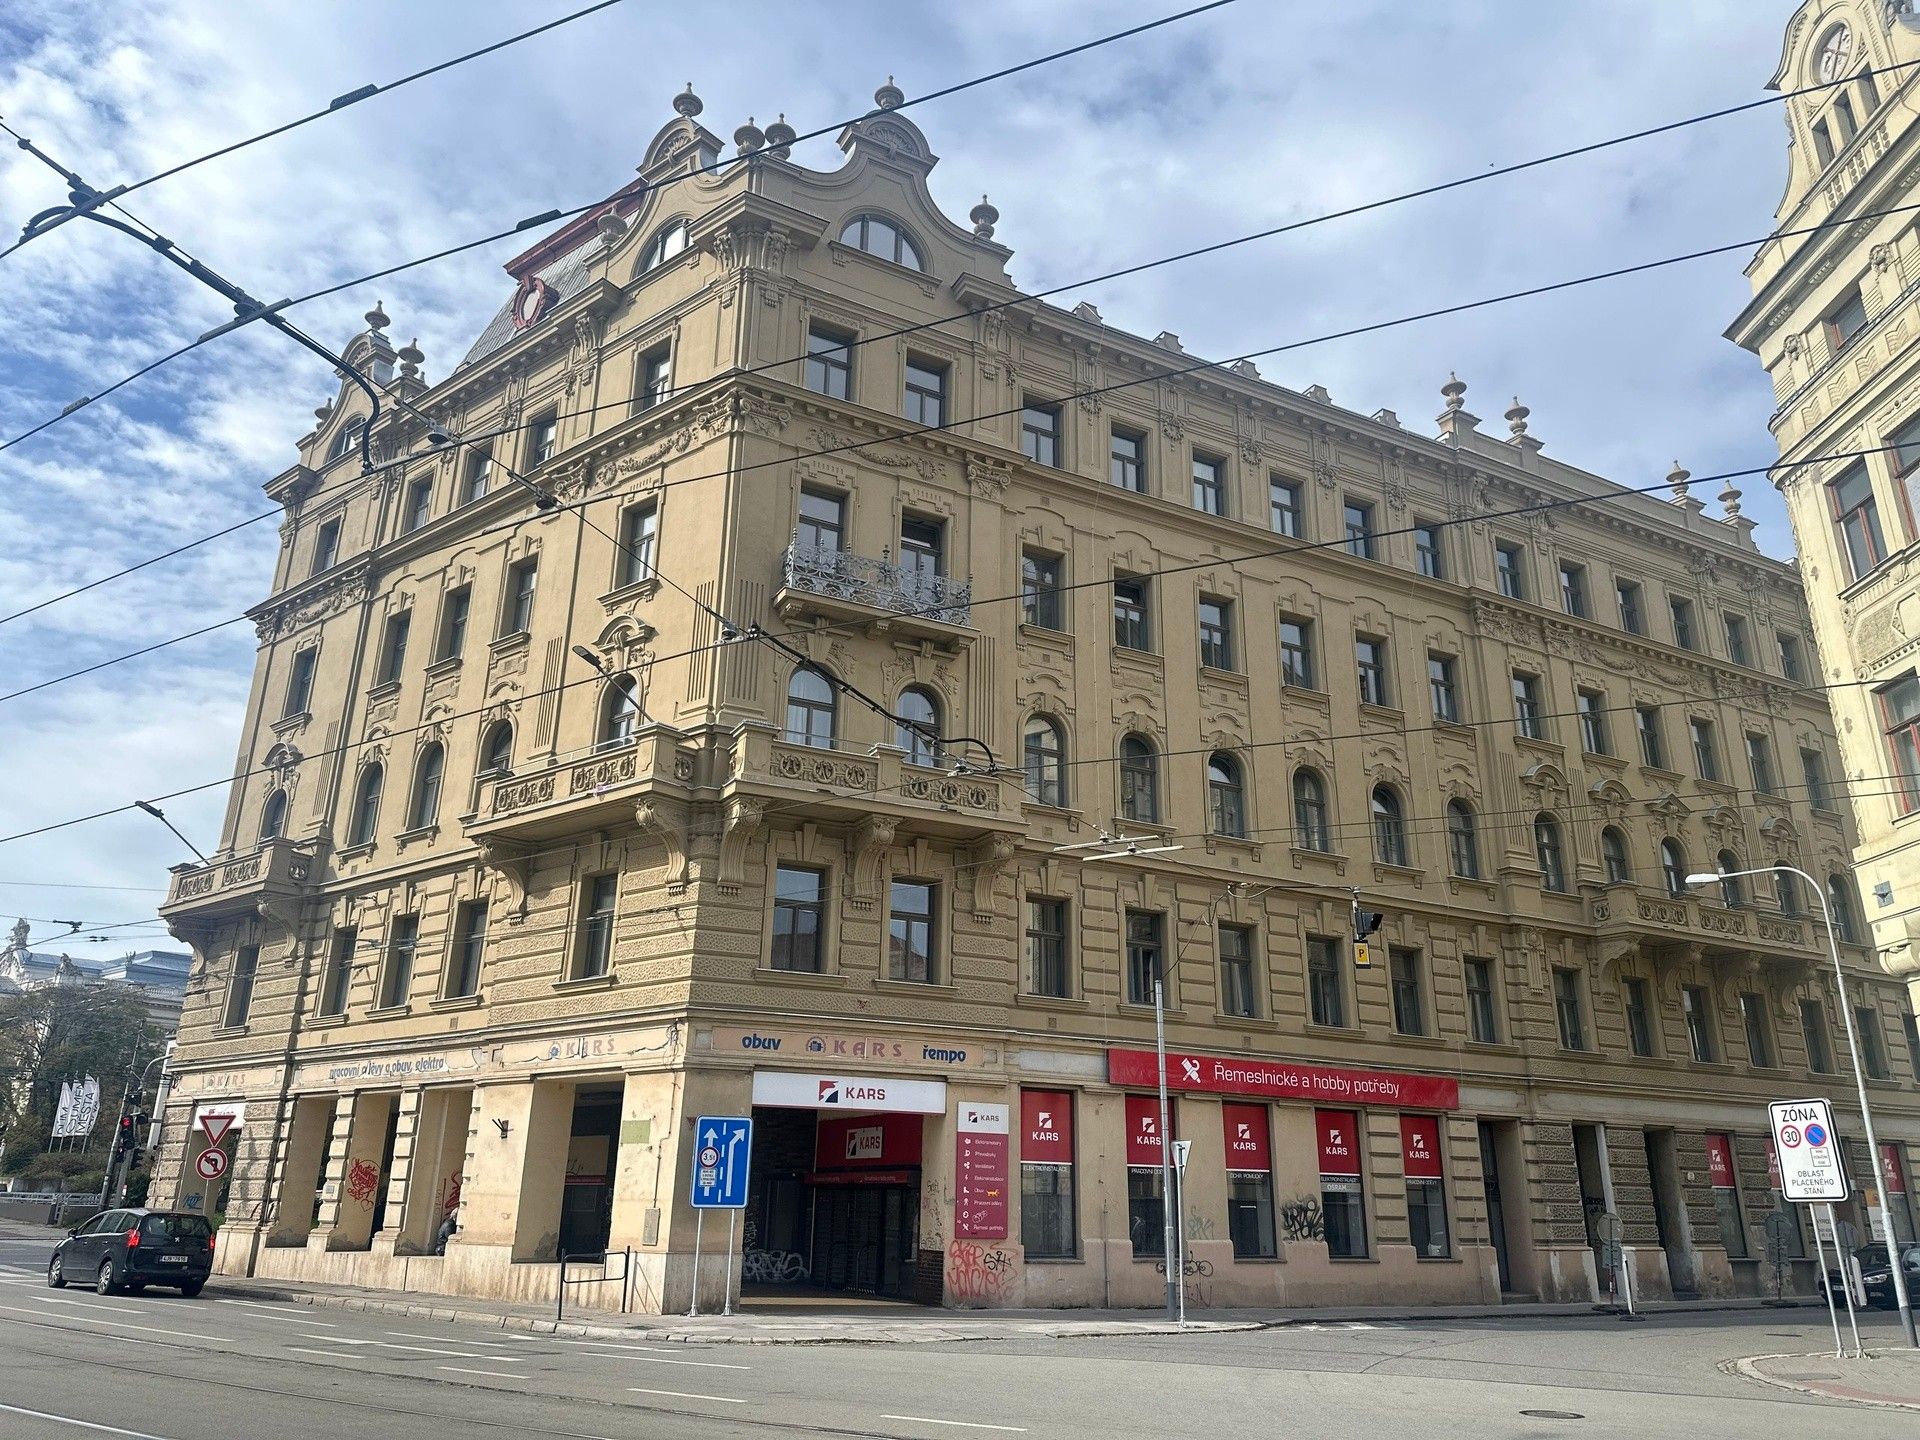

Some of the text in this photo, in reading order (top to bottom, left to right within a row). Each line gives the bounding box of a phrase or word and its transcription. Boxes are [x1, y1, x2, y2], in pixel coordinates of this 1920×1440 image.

[741, 1033, 782, 1051] obuv
[833, 1040, 903, 1058] KARS
[922, 1044, 967, 1063] řempo
[1214, 1060, 1400, 1099] Řemeslnické a hobby potřeby
[845, 1086, 886, 1101] KARS
[1781, 1106, 1819, 1123] ZÓNA
[1032, 1131, 1059, 1142] KARS
[1136, 1135, 1162, 1146] KARS
[1784, 1130, 1798, 1143] 30
[859, 1135, 881, 1150] KARS
[1233, 1141, 1257, 1151] KARS
[1325, 1146, 1348, 1156] KARS
[1409, 1150, 1430, 1160] KARS
[1709, 1163, 1727, 1172] KARS
[1797, 1169, 1825, 1178] OBLAST
[1791, 1177, 1835, 1187] PLACENÉHO
[1803, 1186, 1825, 1195] STÁNÍ
